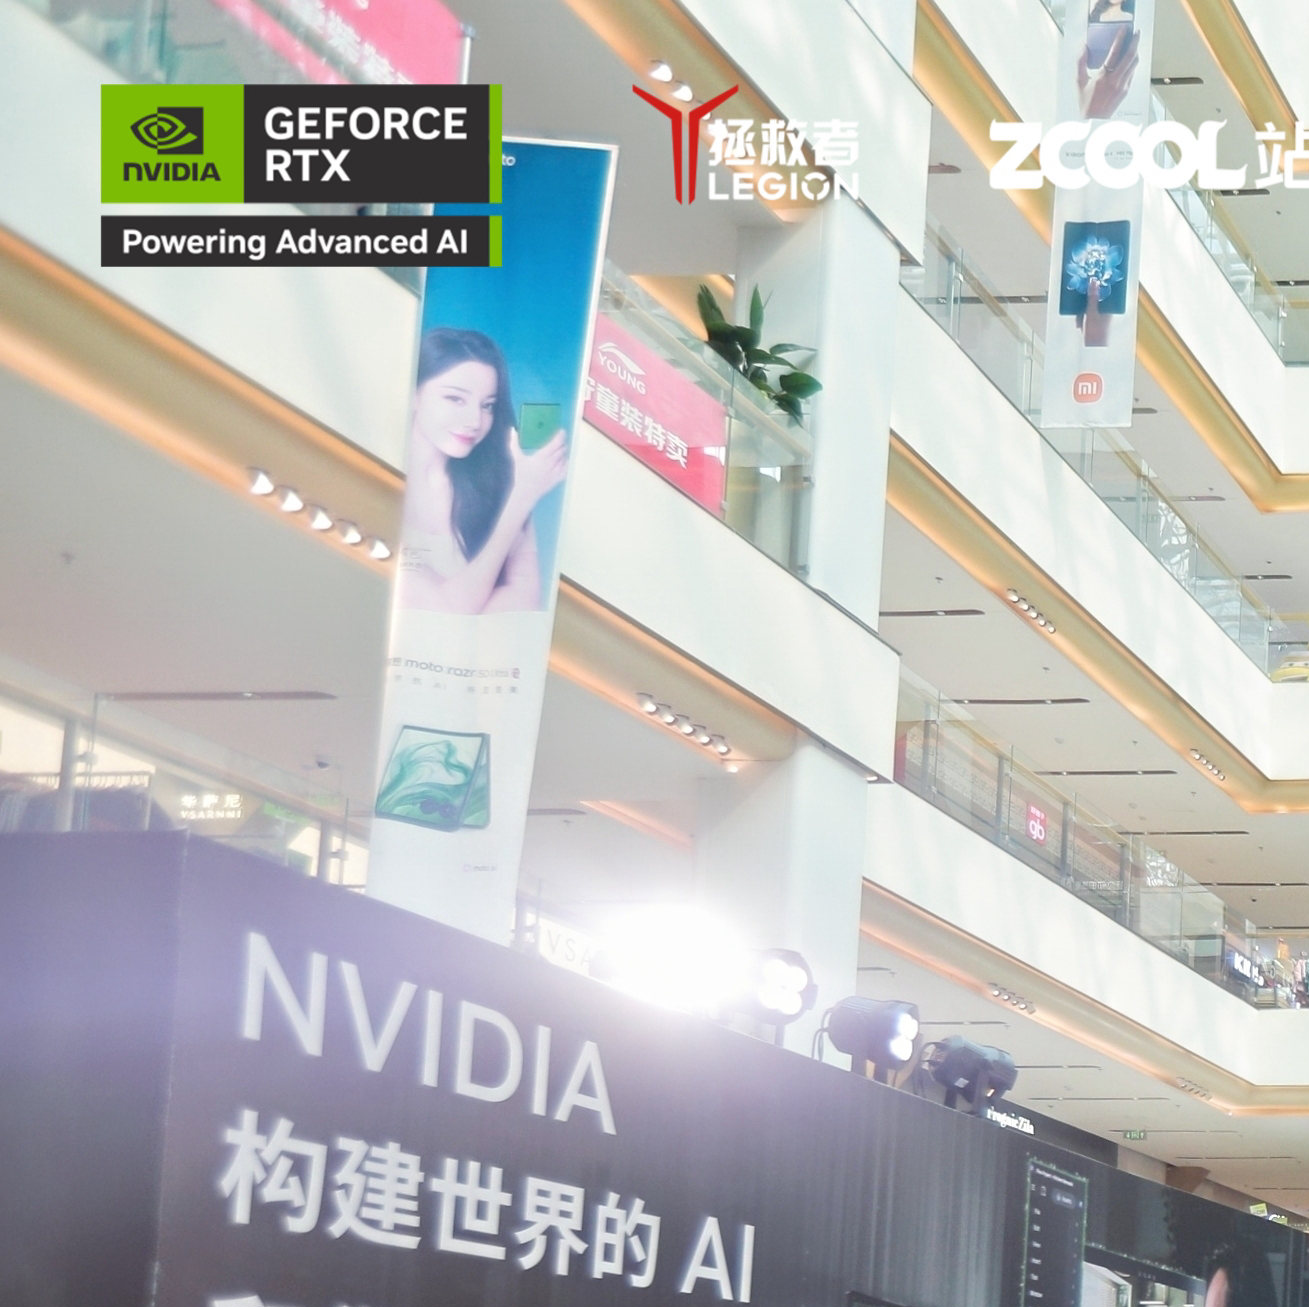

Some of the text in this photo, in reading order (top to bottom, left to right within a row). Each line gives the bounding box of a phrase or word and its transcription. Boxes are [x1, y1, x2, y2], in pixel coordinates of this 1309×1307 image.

[597, 351, 647, 396] YOUNG
[405, 657, 443, 674] moto
[1029, 818, 1045, 841] gb
[241, 930, 618, 1137] NVIDIA
[221, 1108, 756, 1304] 构建世界的 AI
